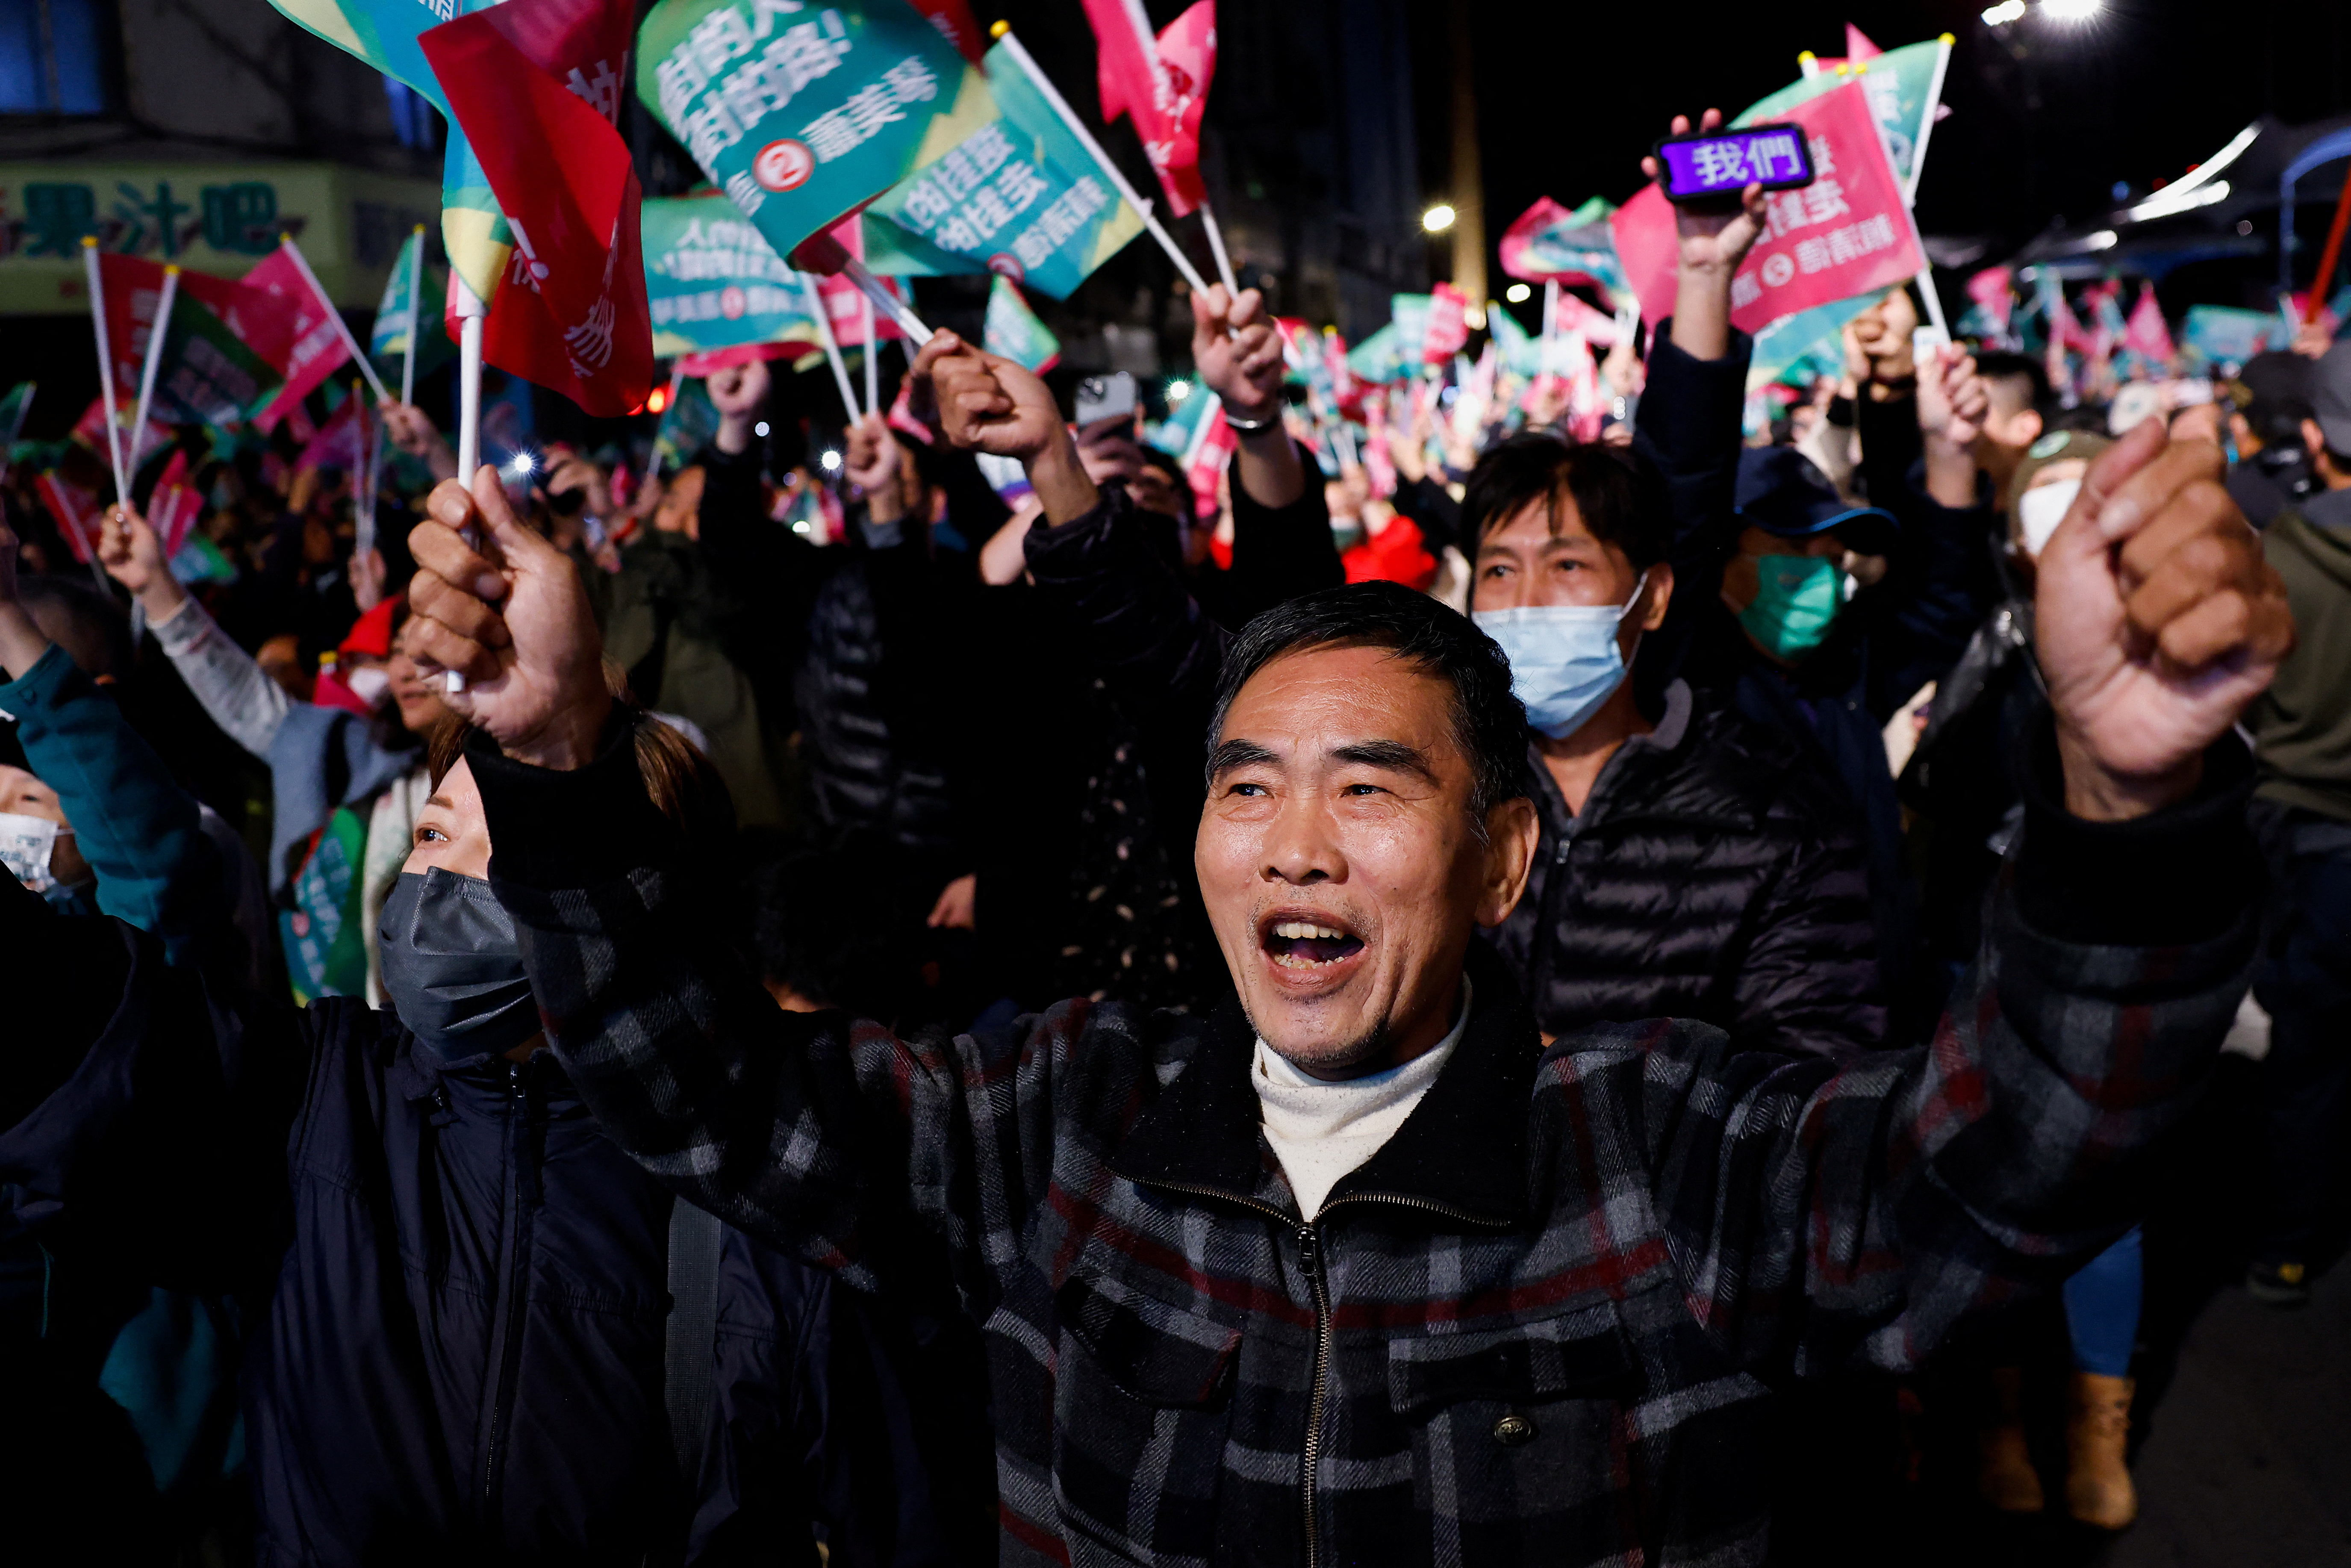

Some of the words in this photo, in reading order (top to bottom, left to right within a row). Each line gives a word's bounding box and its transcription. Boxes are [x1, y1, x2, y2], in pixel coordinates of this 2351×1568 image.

[689, 9, 852, 186] 對的路!
[1691, 134, 1803, 185] 我們
